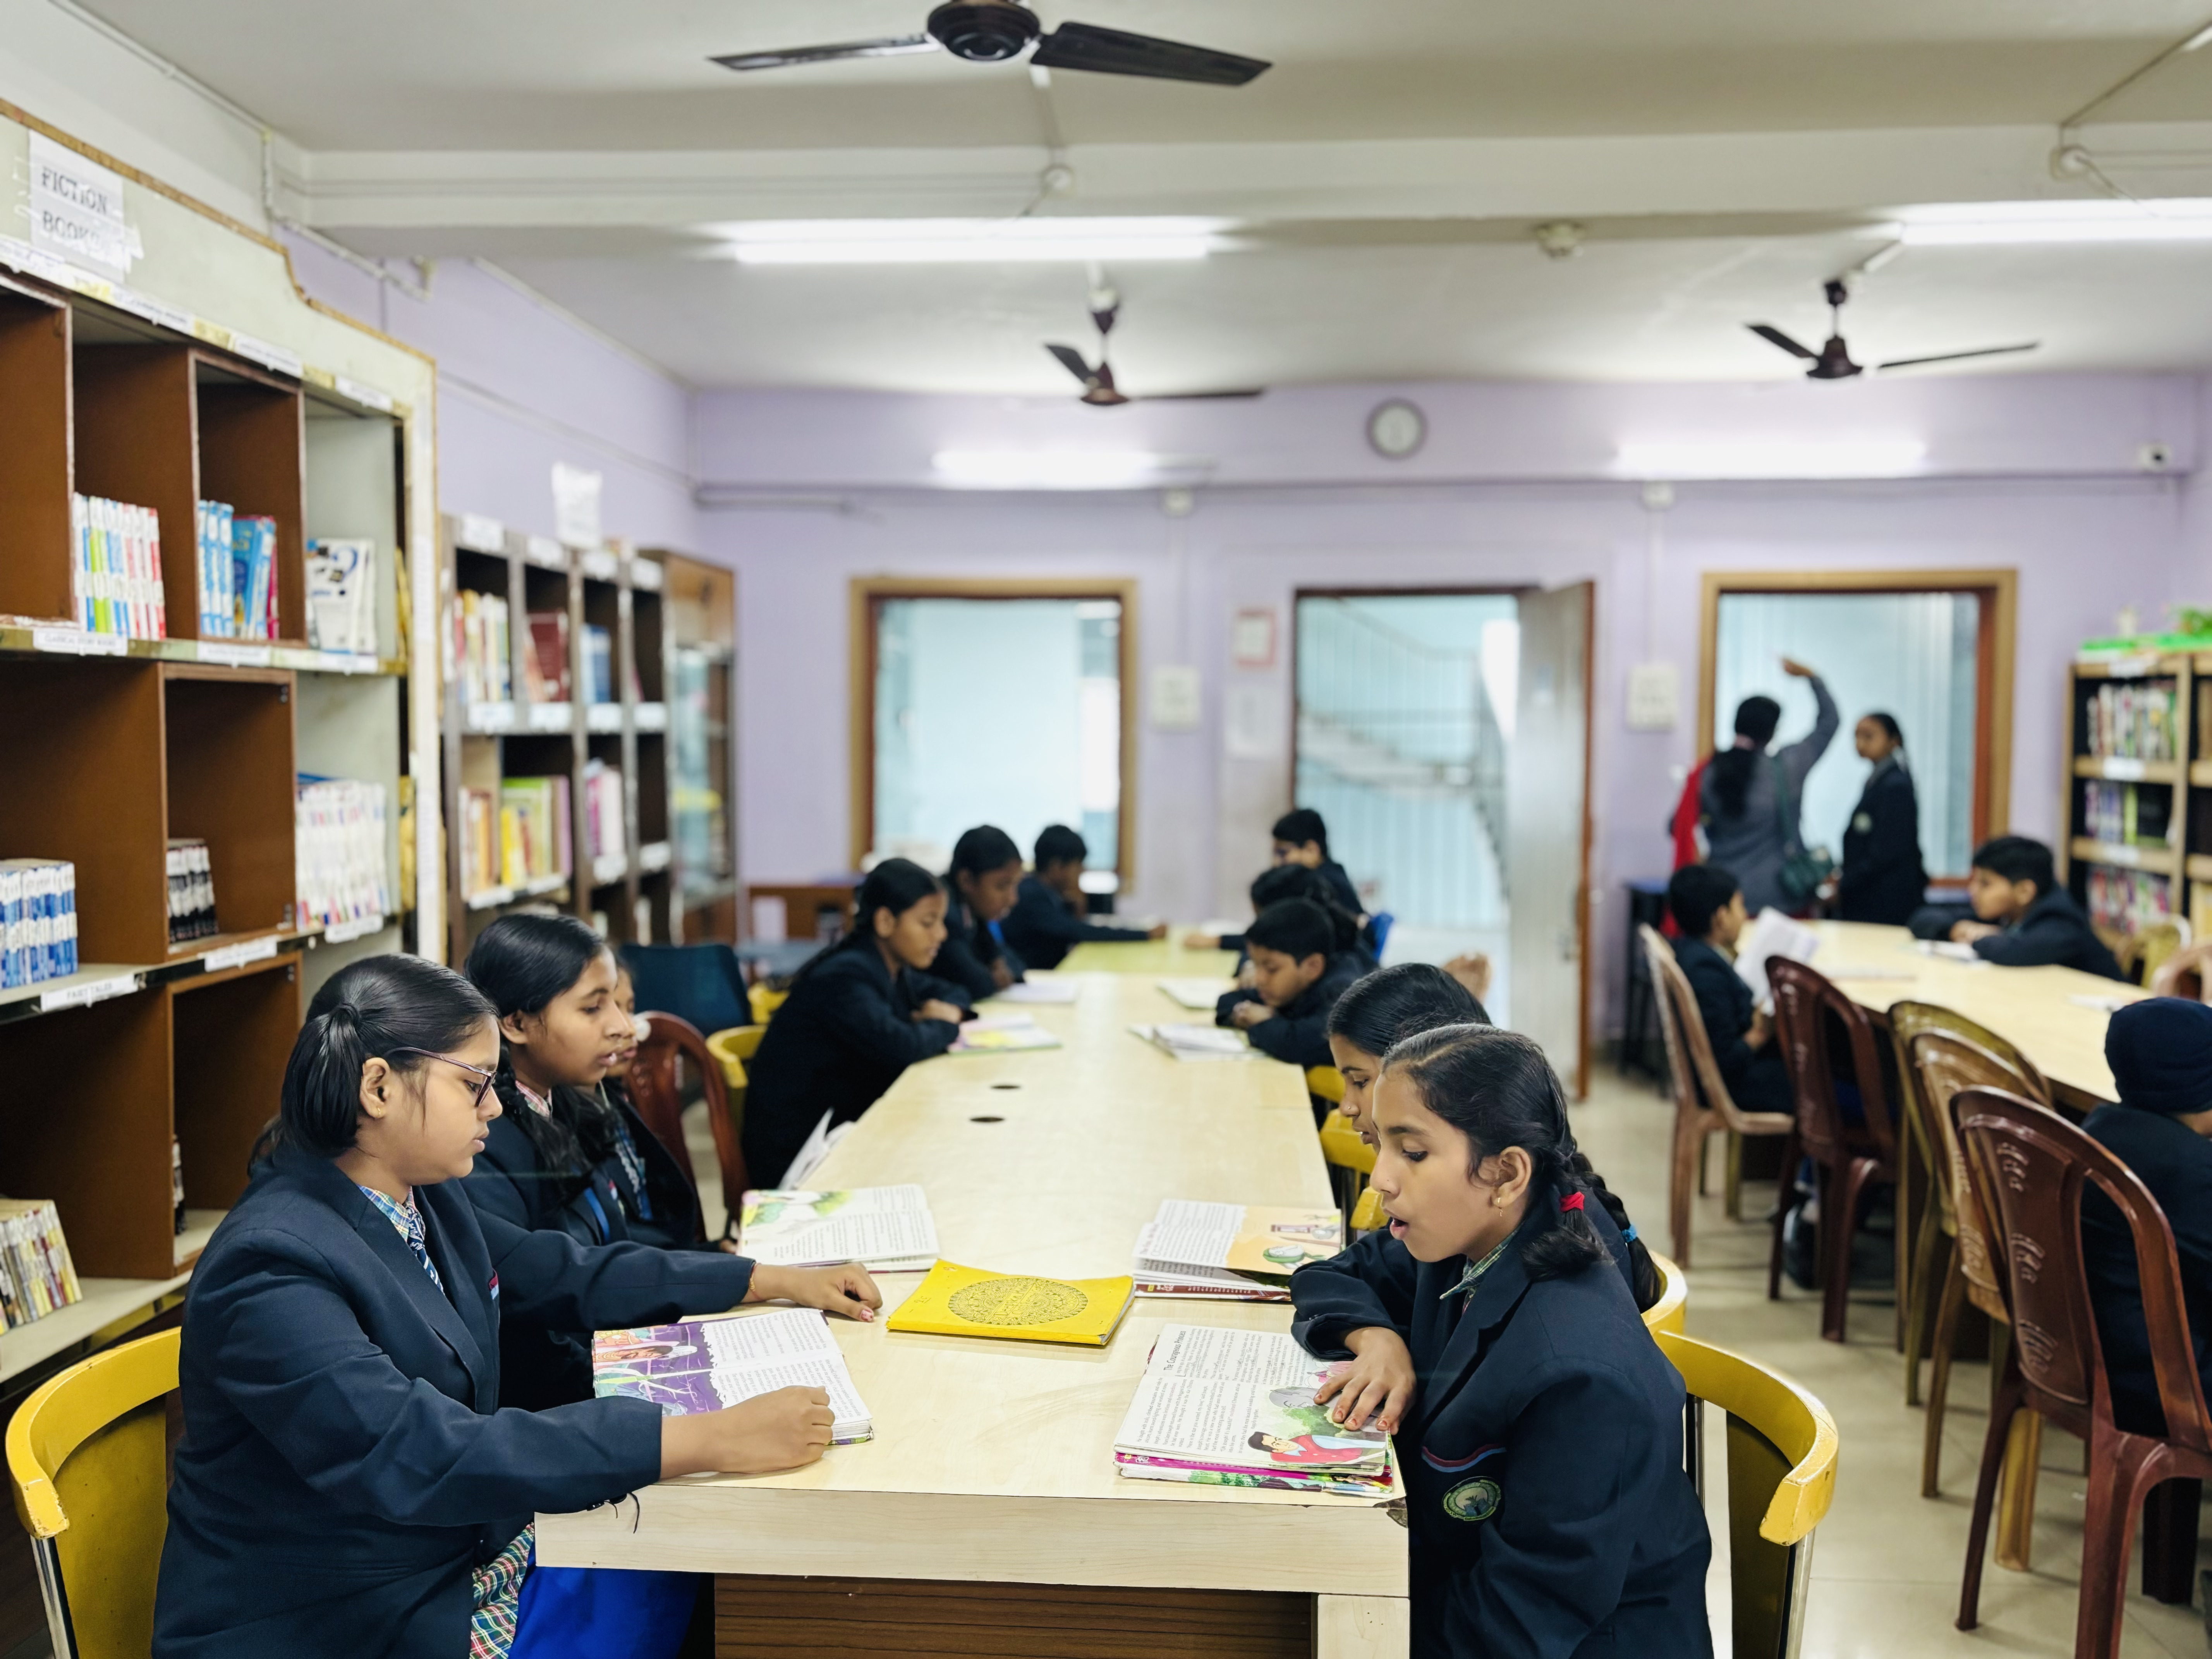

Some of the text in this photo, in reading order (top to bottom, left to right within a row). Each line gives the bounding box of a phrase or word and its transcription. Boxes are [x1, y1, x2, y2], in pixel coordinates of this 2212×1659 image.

[42, 167, 107, 214] FICTION
[1166, 1344, 1181, 1363] Courageous
[1174, 1331, 1186, 1343] Princess
